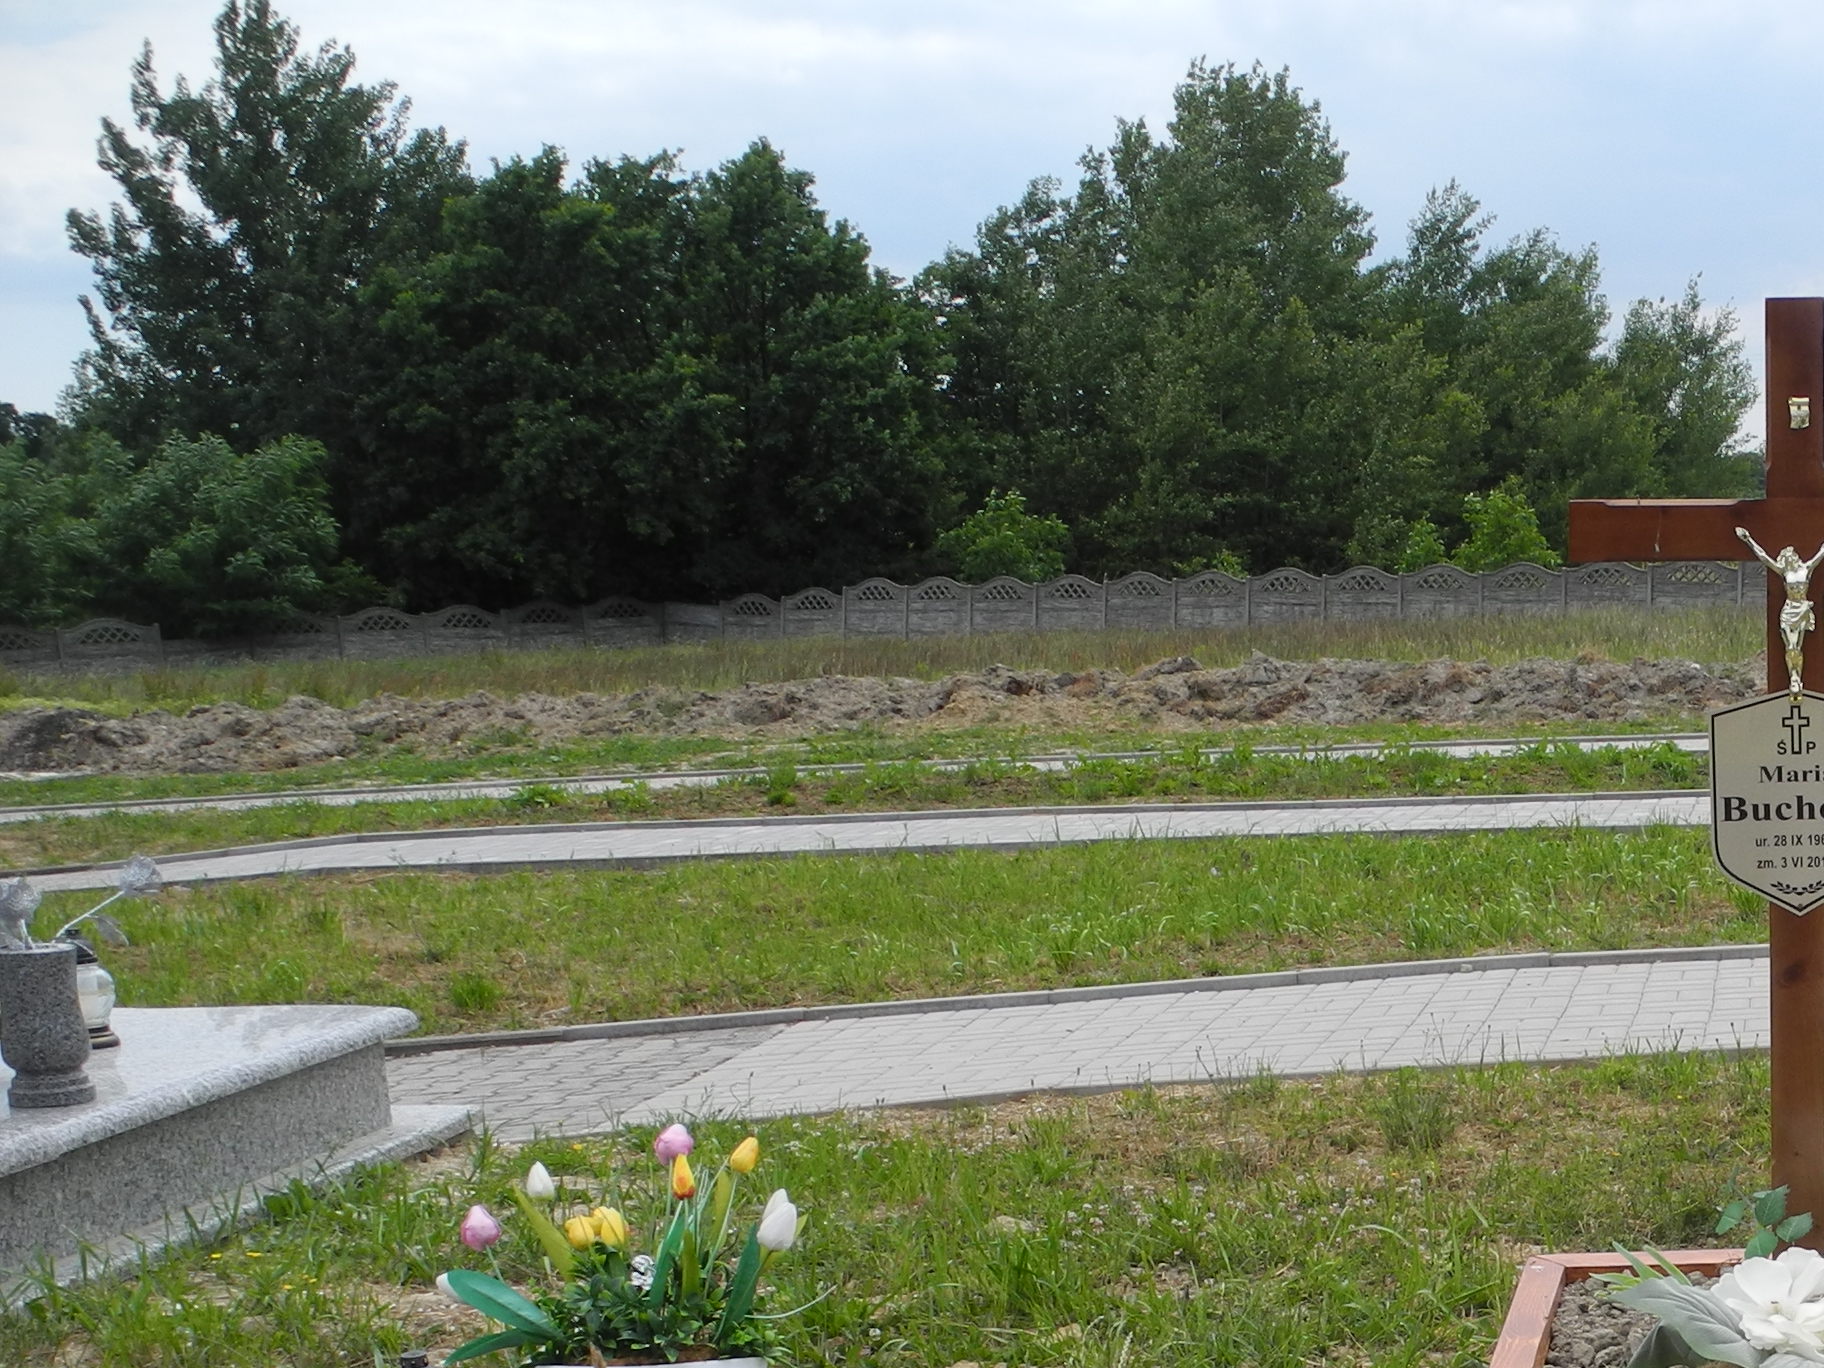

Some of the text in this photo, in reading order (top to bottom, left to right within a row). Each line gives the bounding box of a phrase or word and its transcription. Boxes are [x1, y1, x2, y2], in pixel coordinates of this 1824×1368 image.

[1777, 739, 1816, 755] Ś P
[1755, 837, 1771, 848] ur.
[1773, 834, 1788, 847] 28
[1791, 834, 1803, 847] IX
[1757, 859, 1778, 869] zm.
[1781, 856, 1788, 869] 3
[1791, 856, 1803, 868] VI
